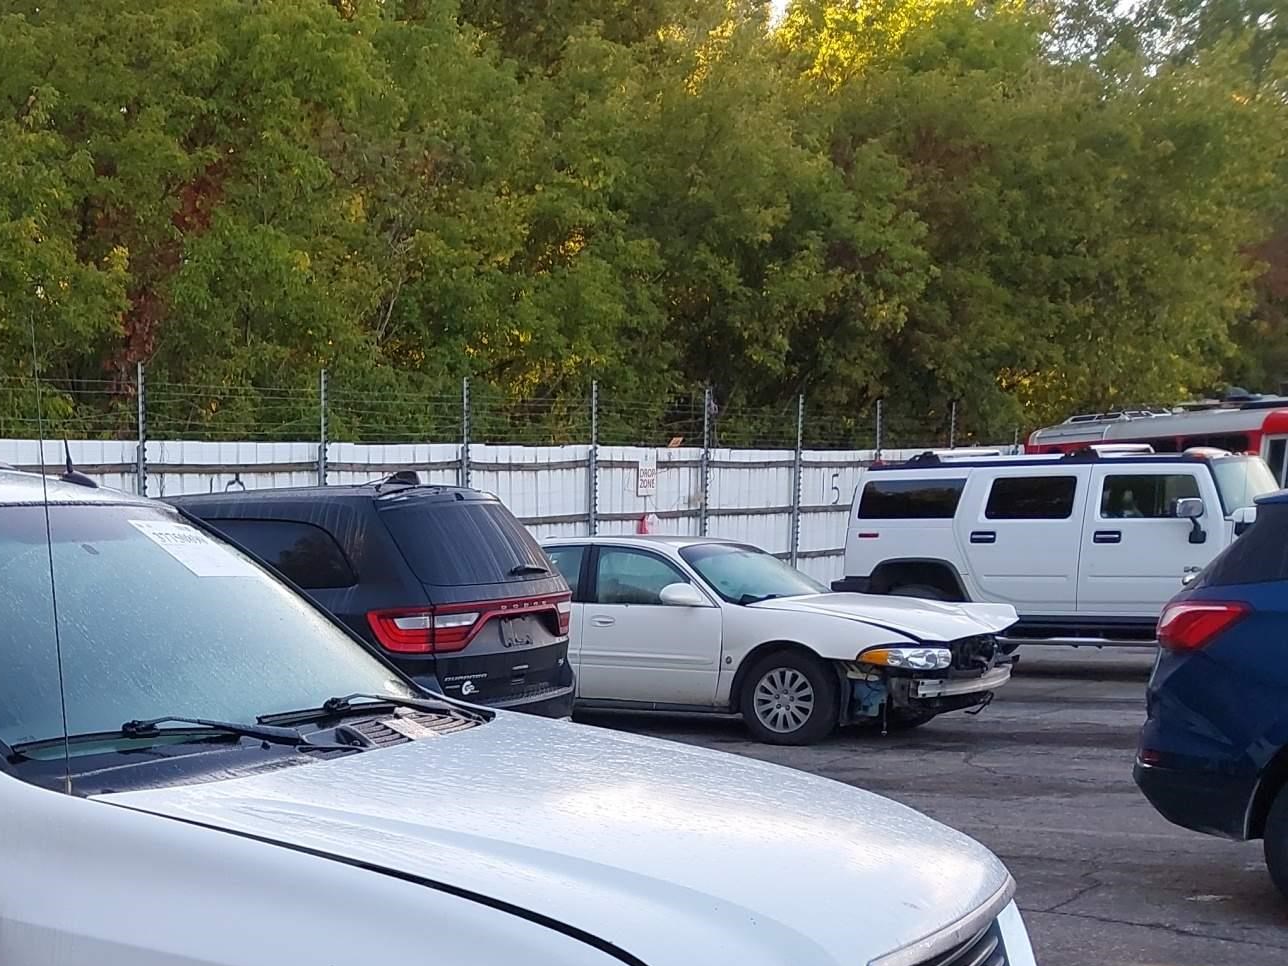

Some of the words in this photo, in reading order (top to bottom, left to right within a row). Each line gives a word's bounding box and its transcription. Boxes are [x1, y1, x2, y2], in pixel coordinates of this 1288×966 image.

[640, 468, 656, 478] DROP
[640, 479, 655, 488] ZONE
[500, 600, 548, 610] DODGE
